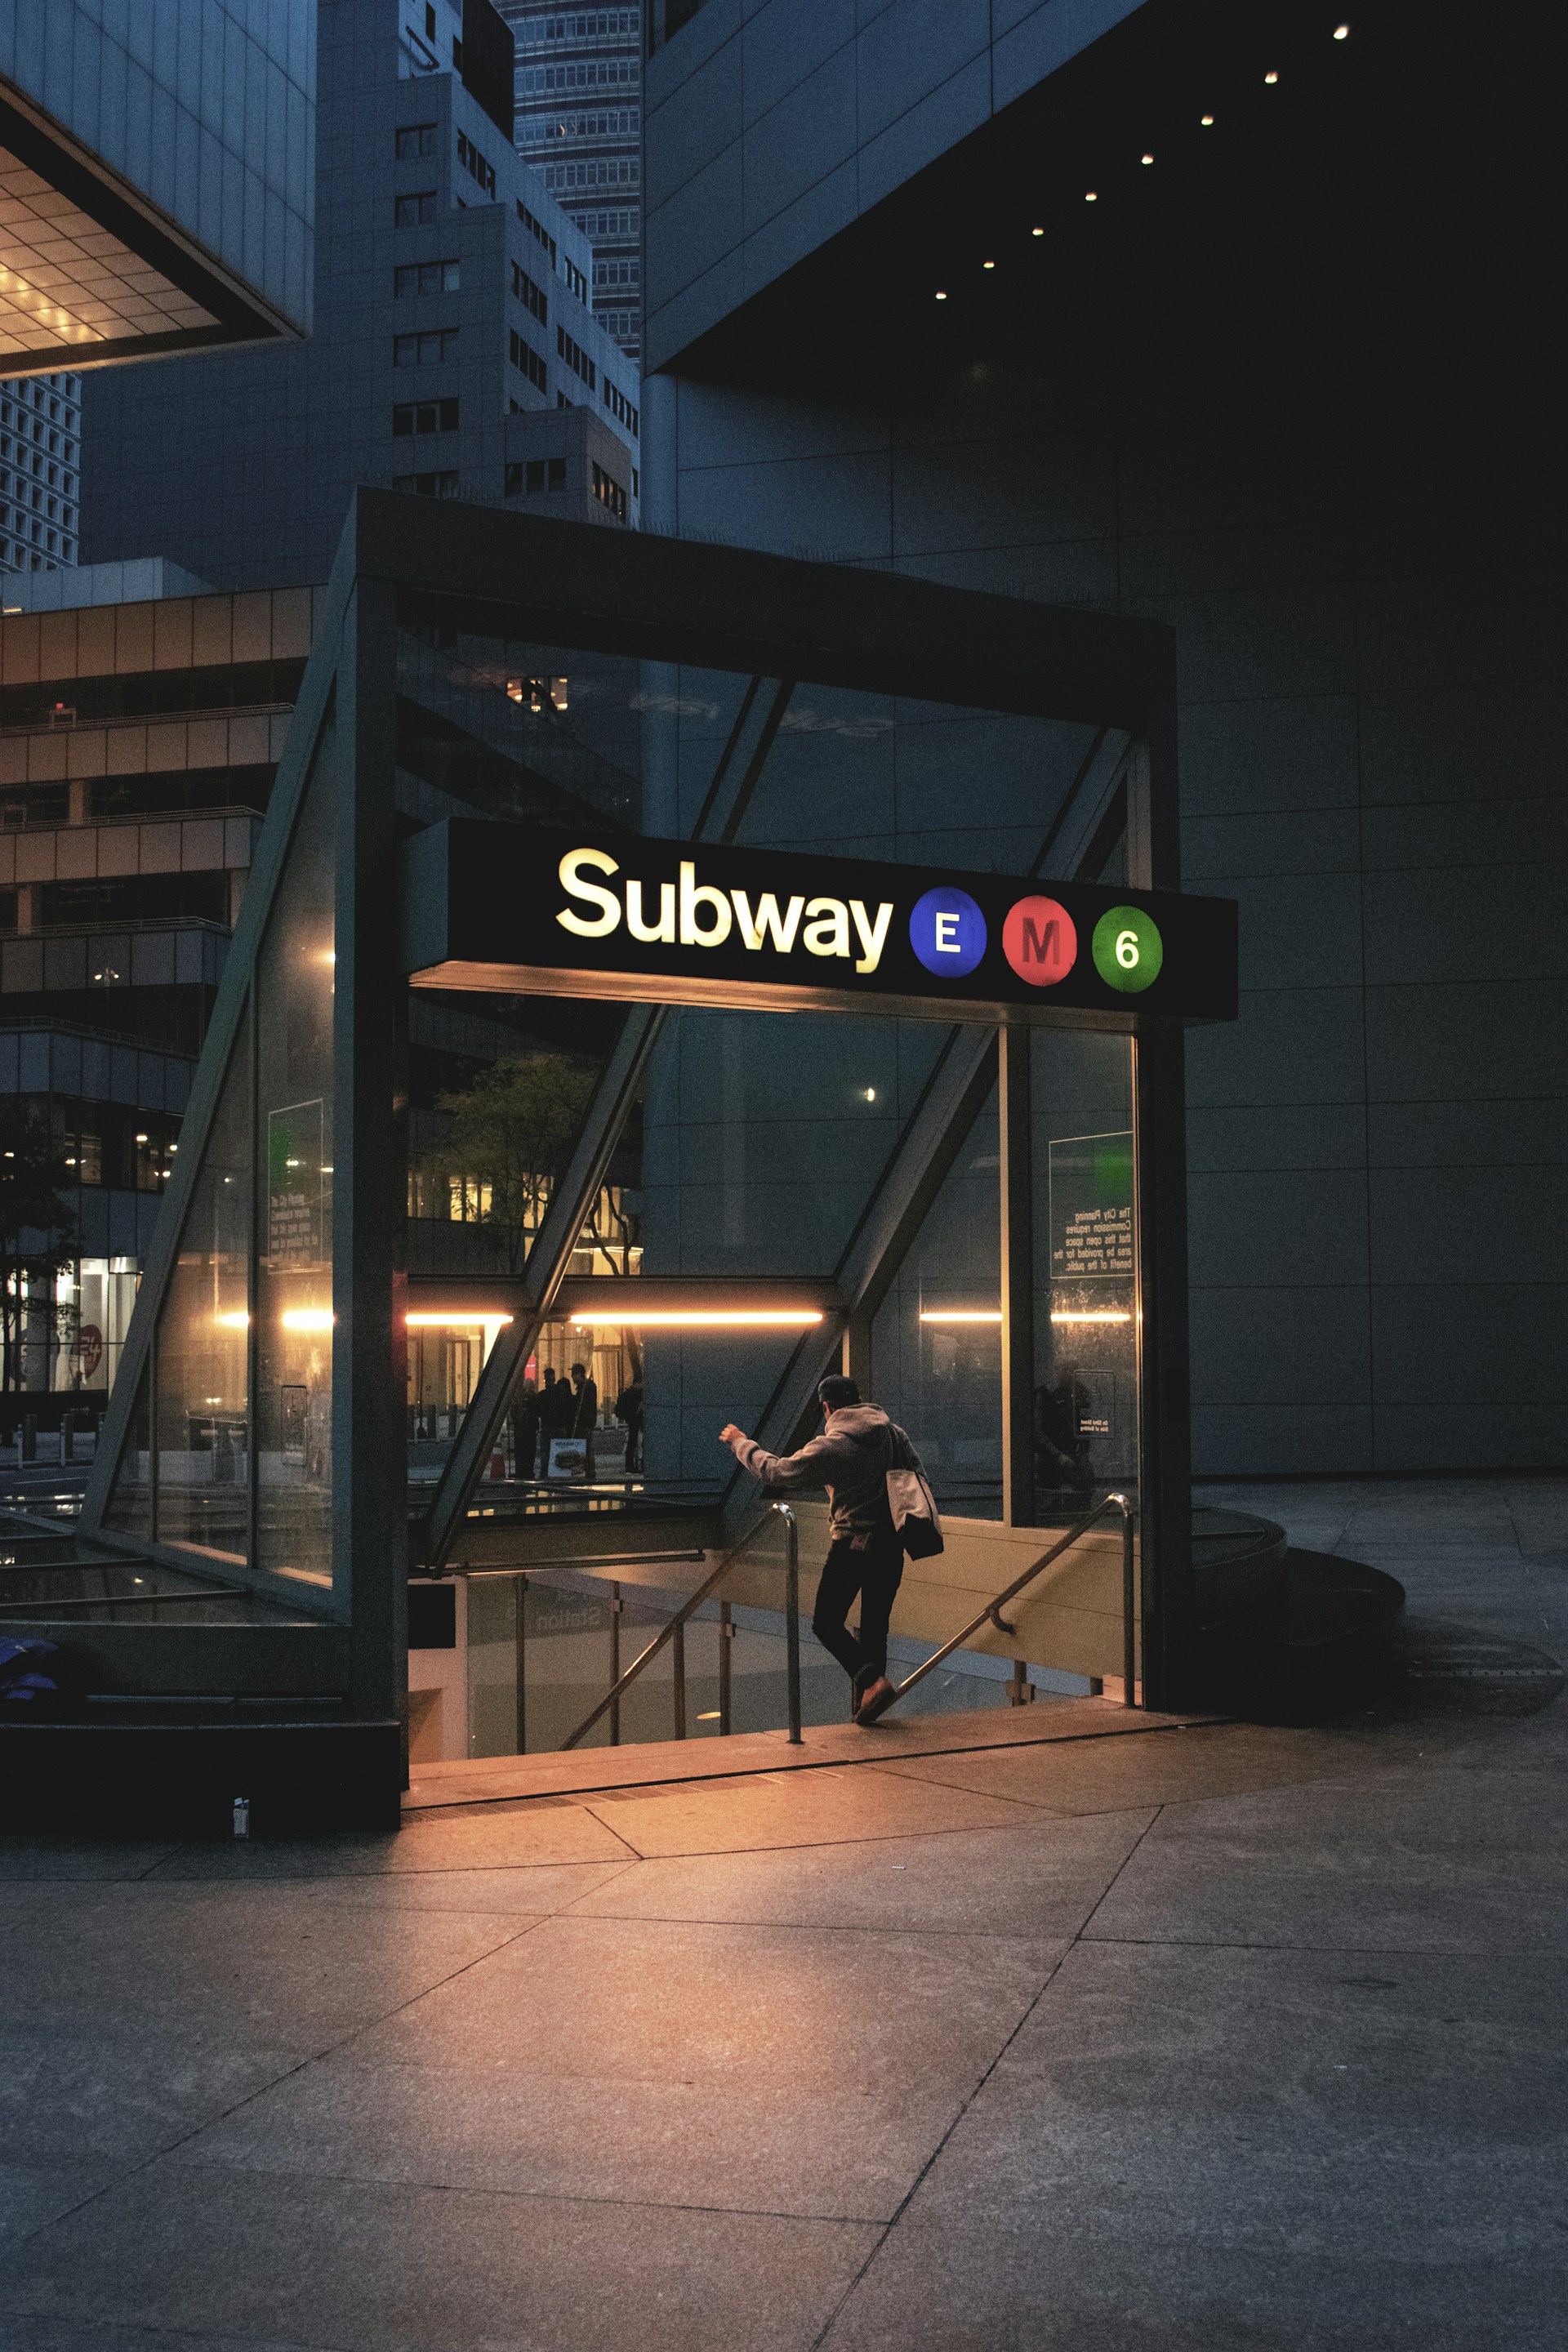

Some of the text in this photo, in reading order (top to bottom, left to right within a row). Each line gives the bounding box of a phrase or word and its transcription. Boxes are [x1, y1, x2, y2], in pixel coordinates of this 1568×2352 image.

[556, 848, 1138, 974] Subway E M 6
